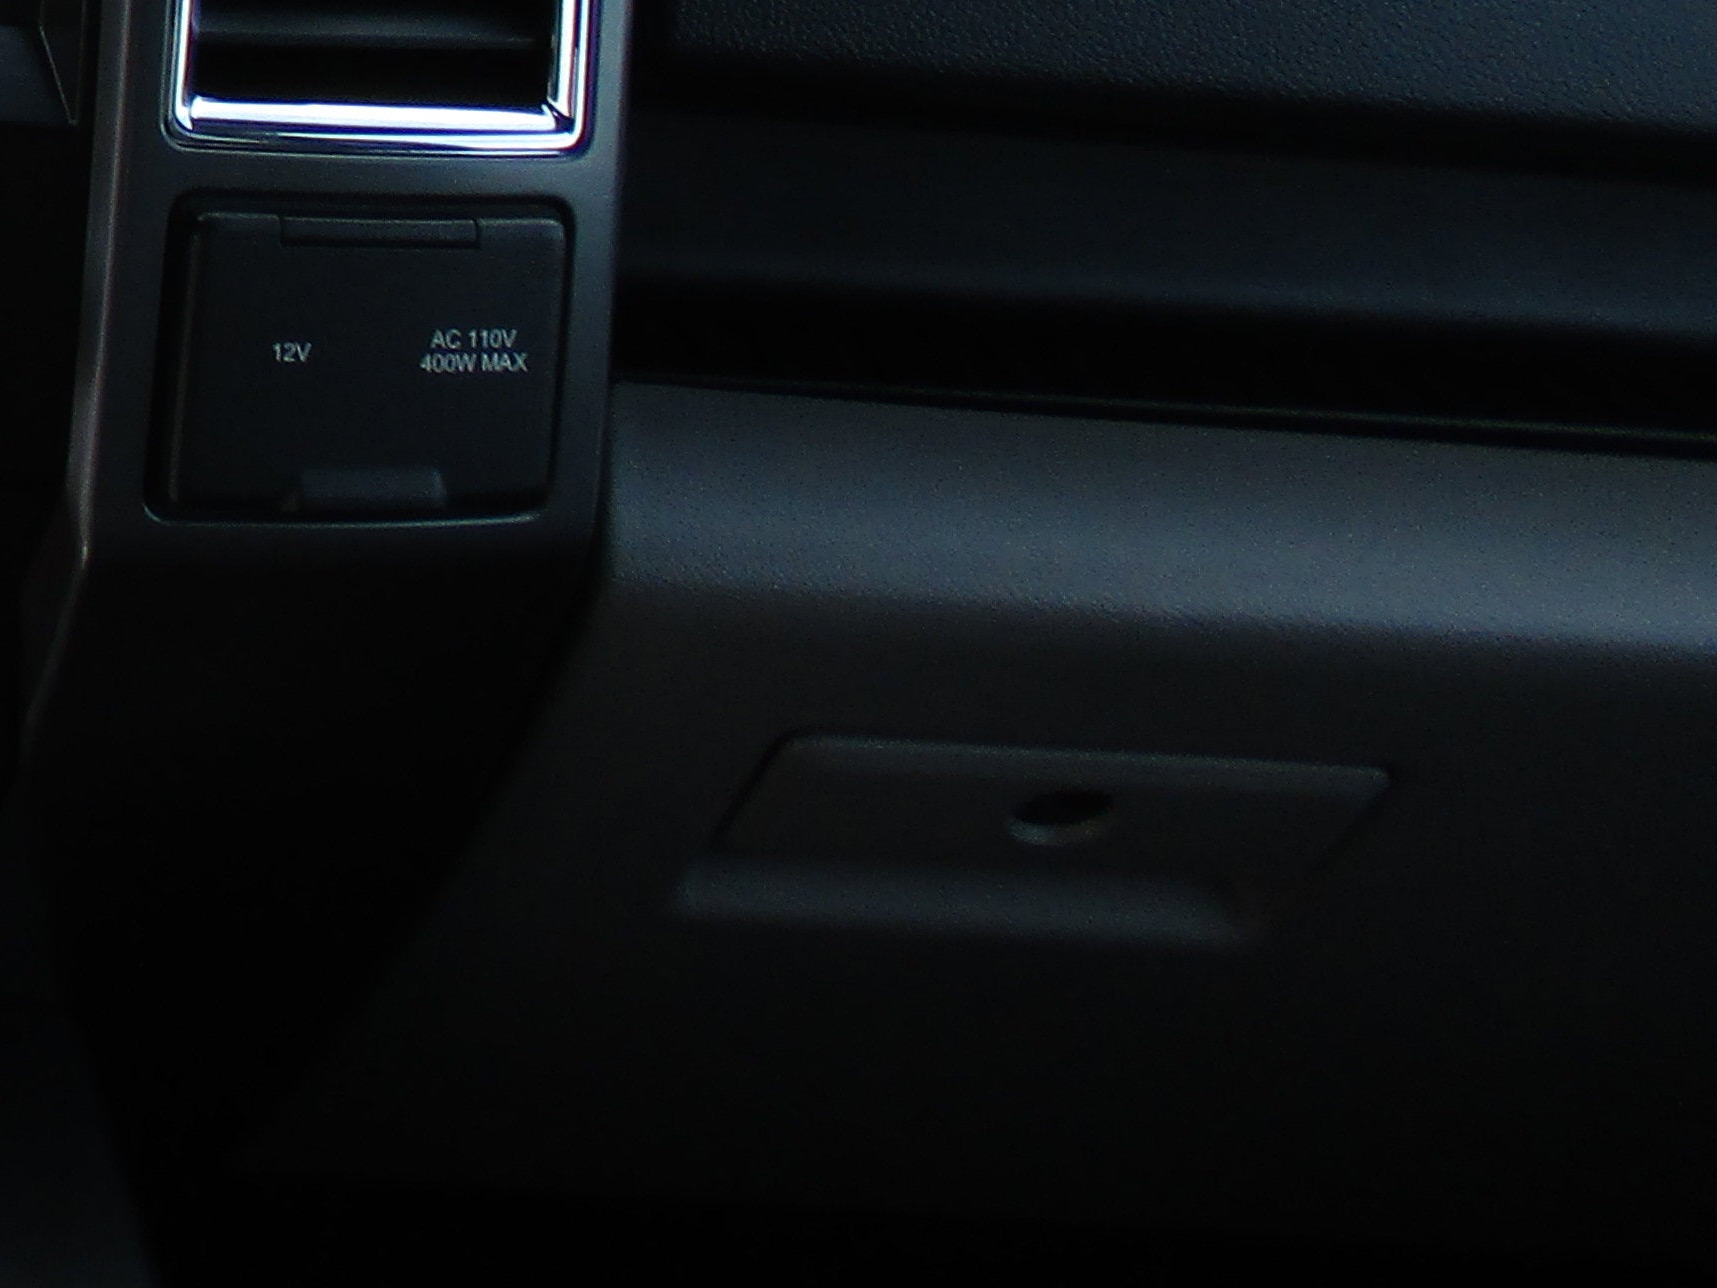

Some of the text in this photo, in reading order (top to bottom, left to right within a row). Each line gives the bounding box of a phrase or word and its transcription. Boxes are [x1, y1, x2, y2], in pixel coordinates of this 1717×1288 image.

[429, 327, 518, 350] AC 110V
[271, 340, 313, 363] 12V
[418, 351, 530, 374] 400W MAX
